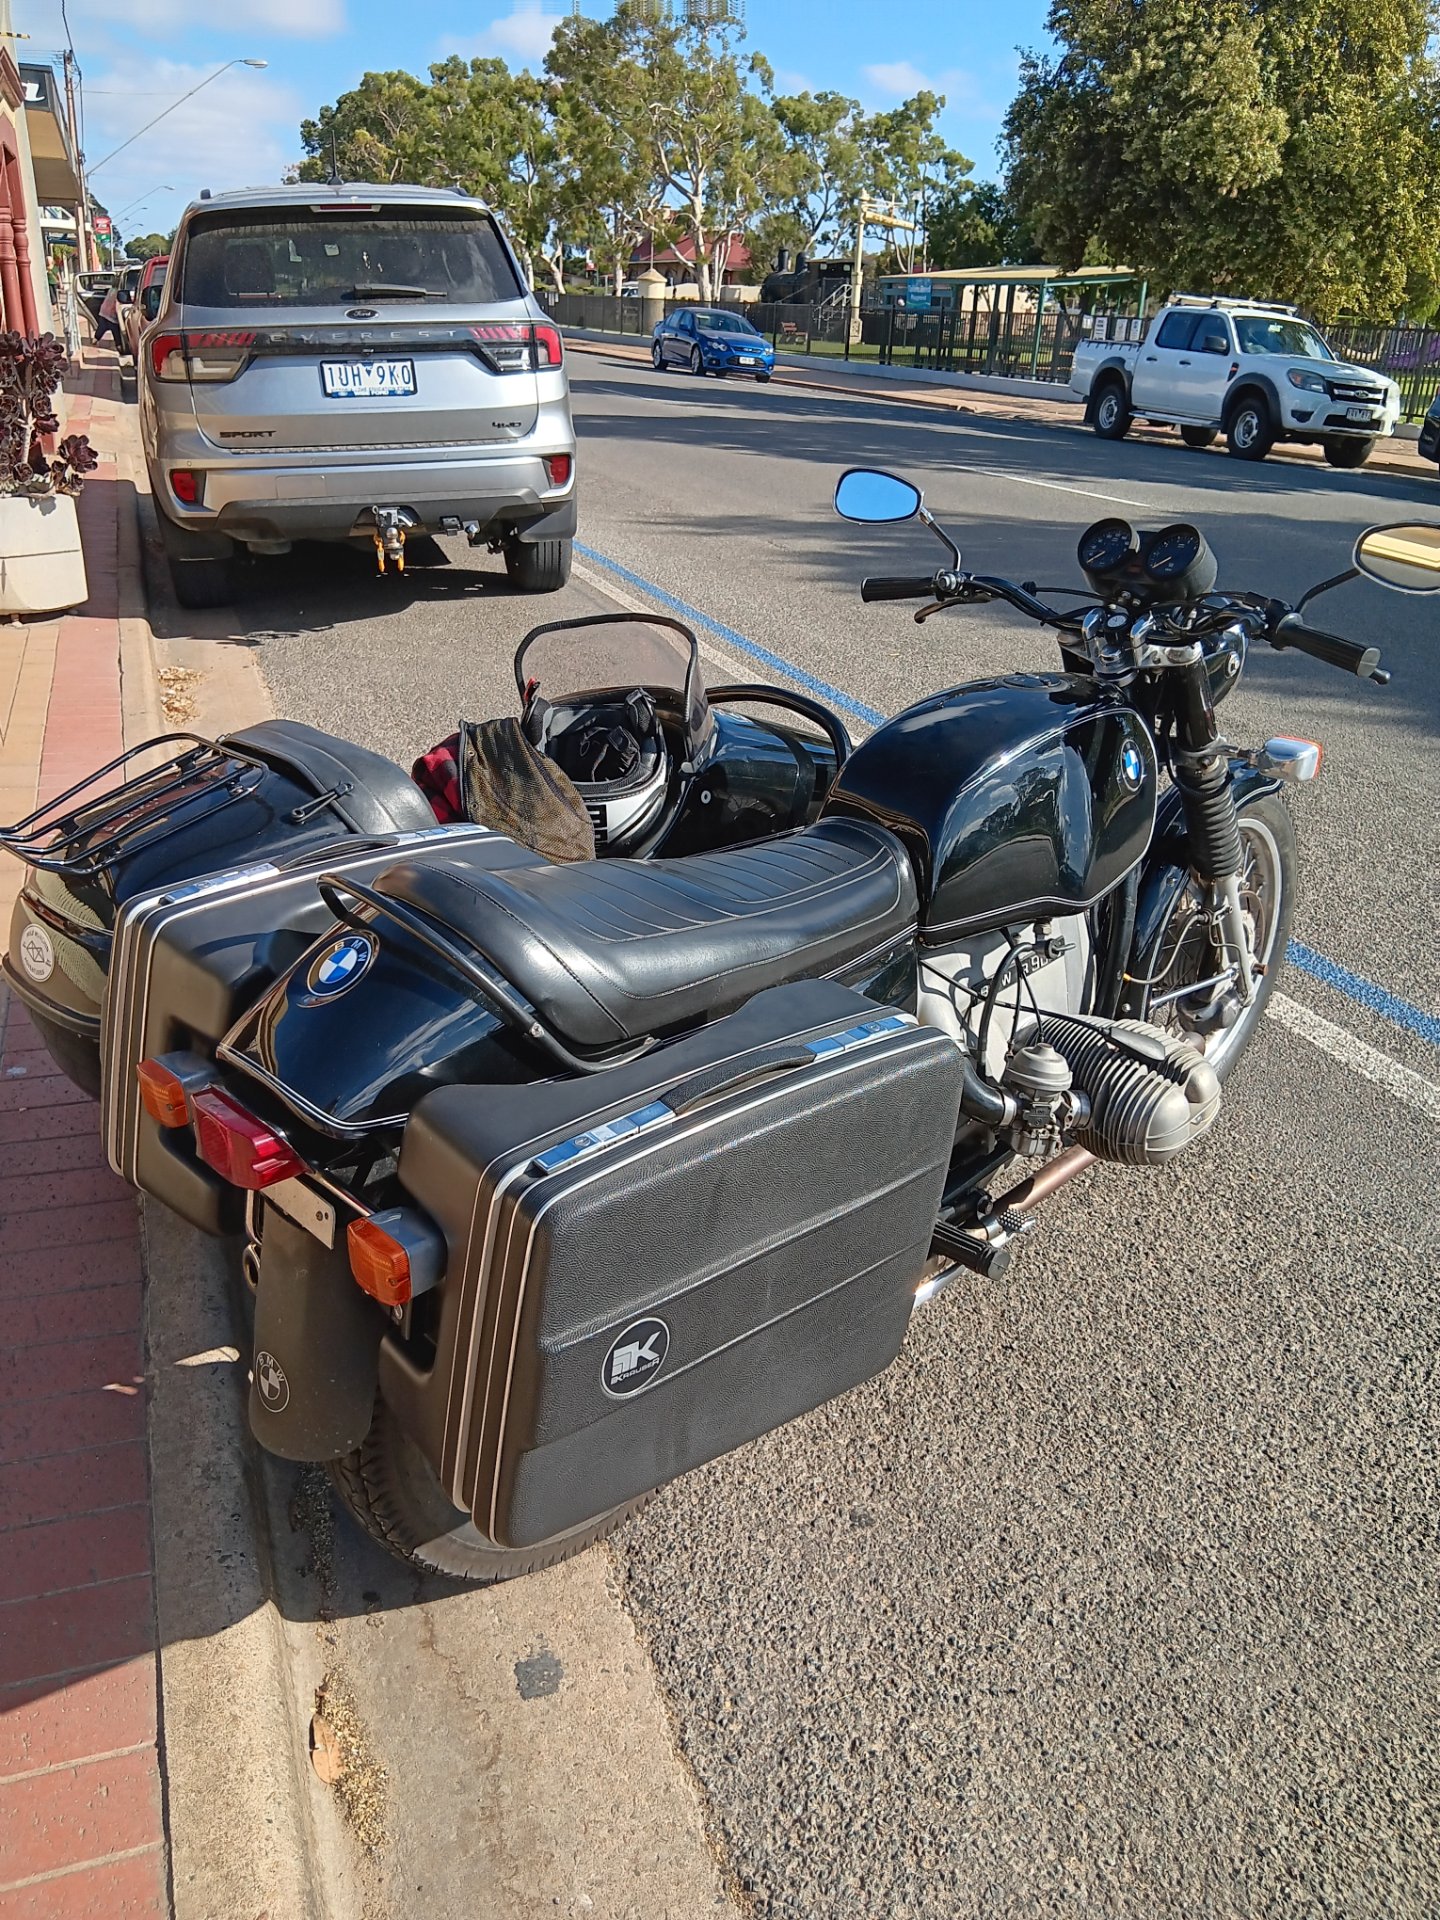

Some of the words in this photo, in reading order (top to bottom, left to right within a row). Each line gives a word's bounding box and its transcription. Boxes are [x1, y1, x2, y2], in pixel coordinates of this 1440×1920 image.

[269, 330, 457, 342] EVEREST
[327, 365, 362, 387] 1UH
[219, 430, 277, 438] SPORT
[334, 939, 368, 962] BMW
[980, 971, 1012, 997] BW
[258, 1354, 285, 1382] BMW
